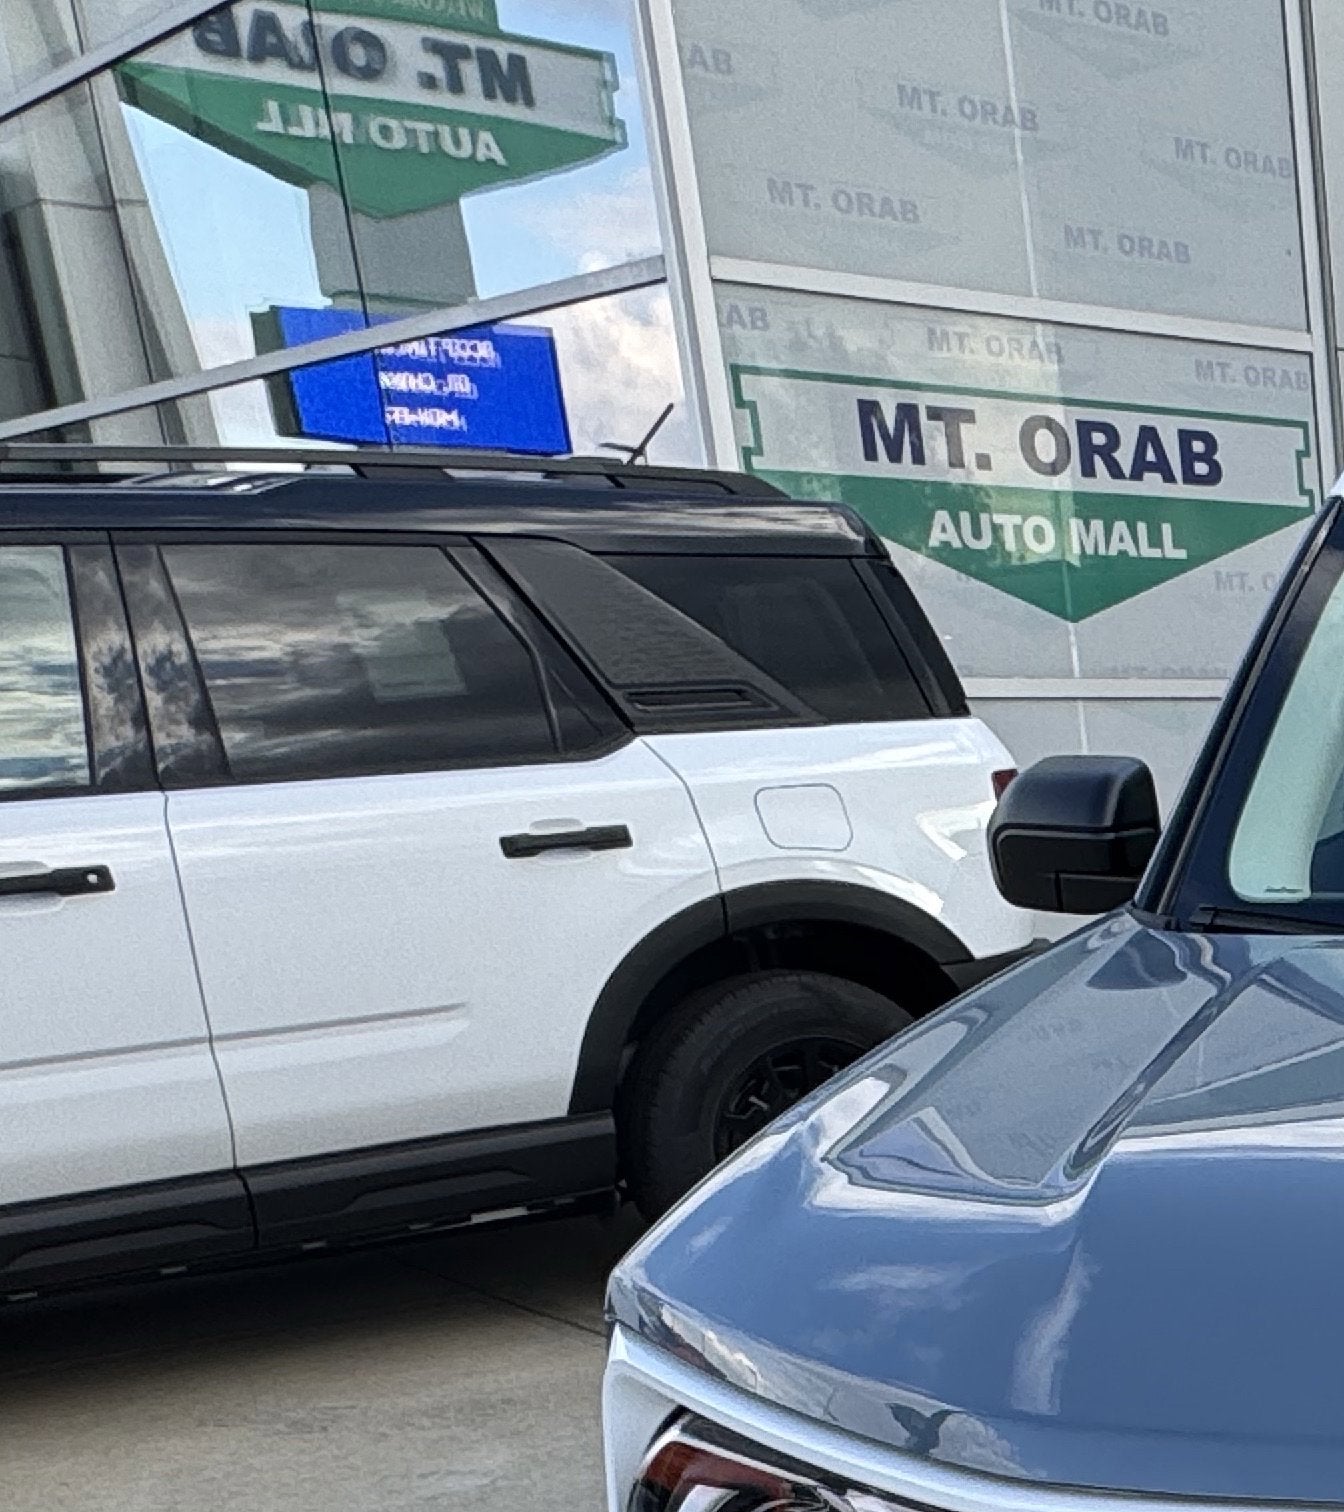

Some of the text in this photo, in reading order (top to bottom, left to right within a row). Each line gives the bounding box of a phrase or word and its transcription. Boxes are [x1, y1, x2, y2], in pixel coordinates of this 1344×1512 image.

[897, 84, 1040, 131] MT. ORAB
[766, 178, 920, 223] MT. ORAB
[1117, 232, 1191, 264] ORAB
[856, 398, 1224, 487] MT. ORAB
[928, 510, 1188, 560] AUTO MALL
